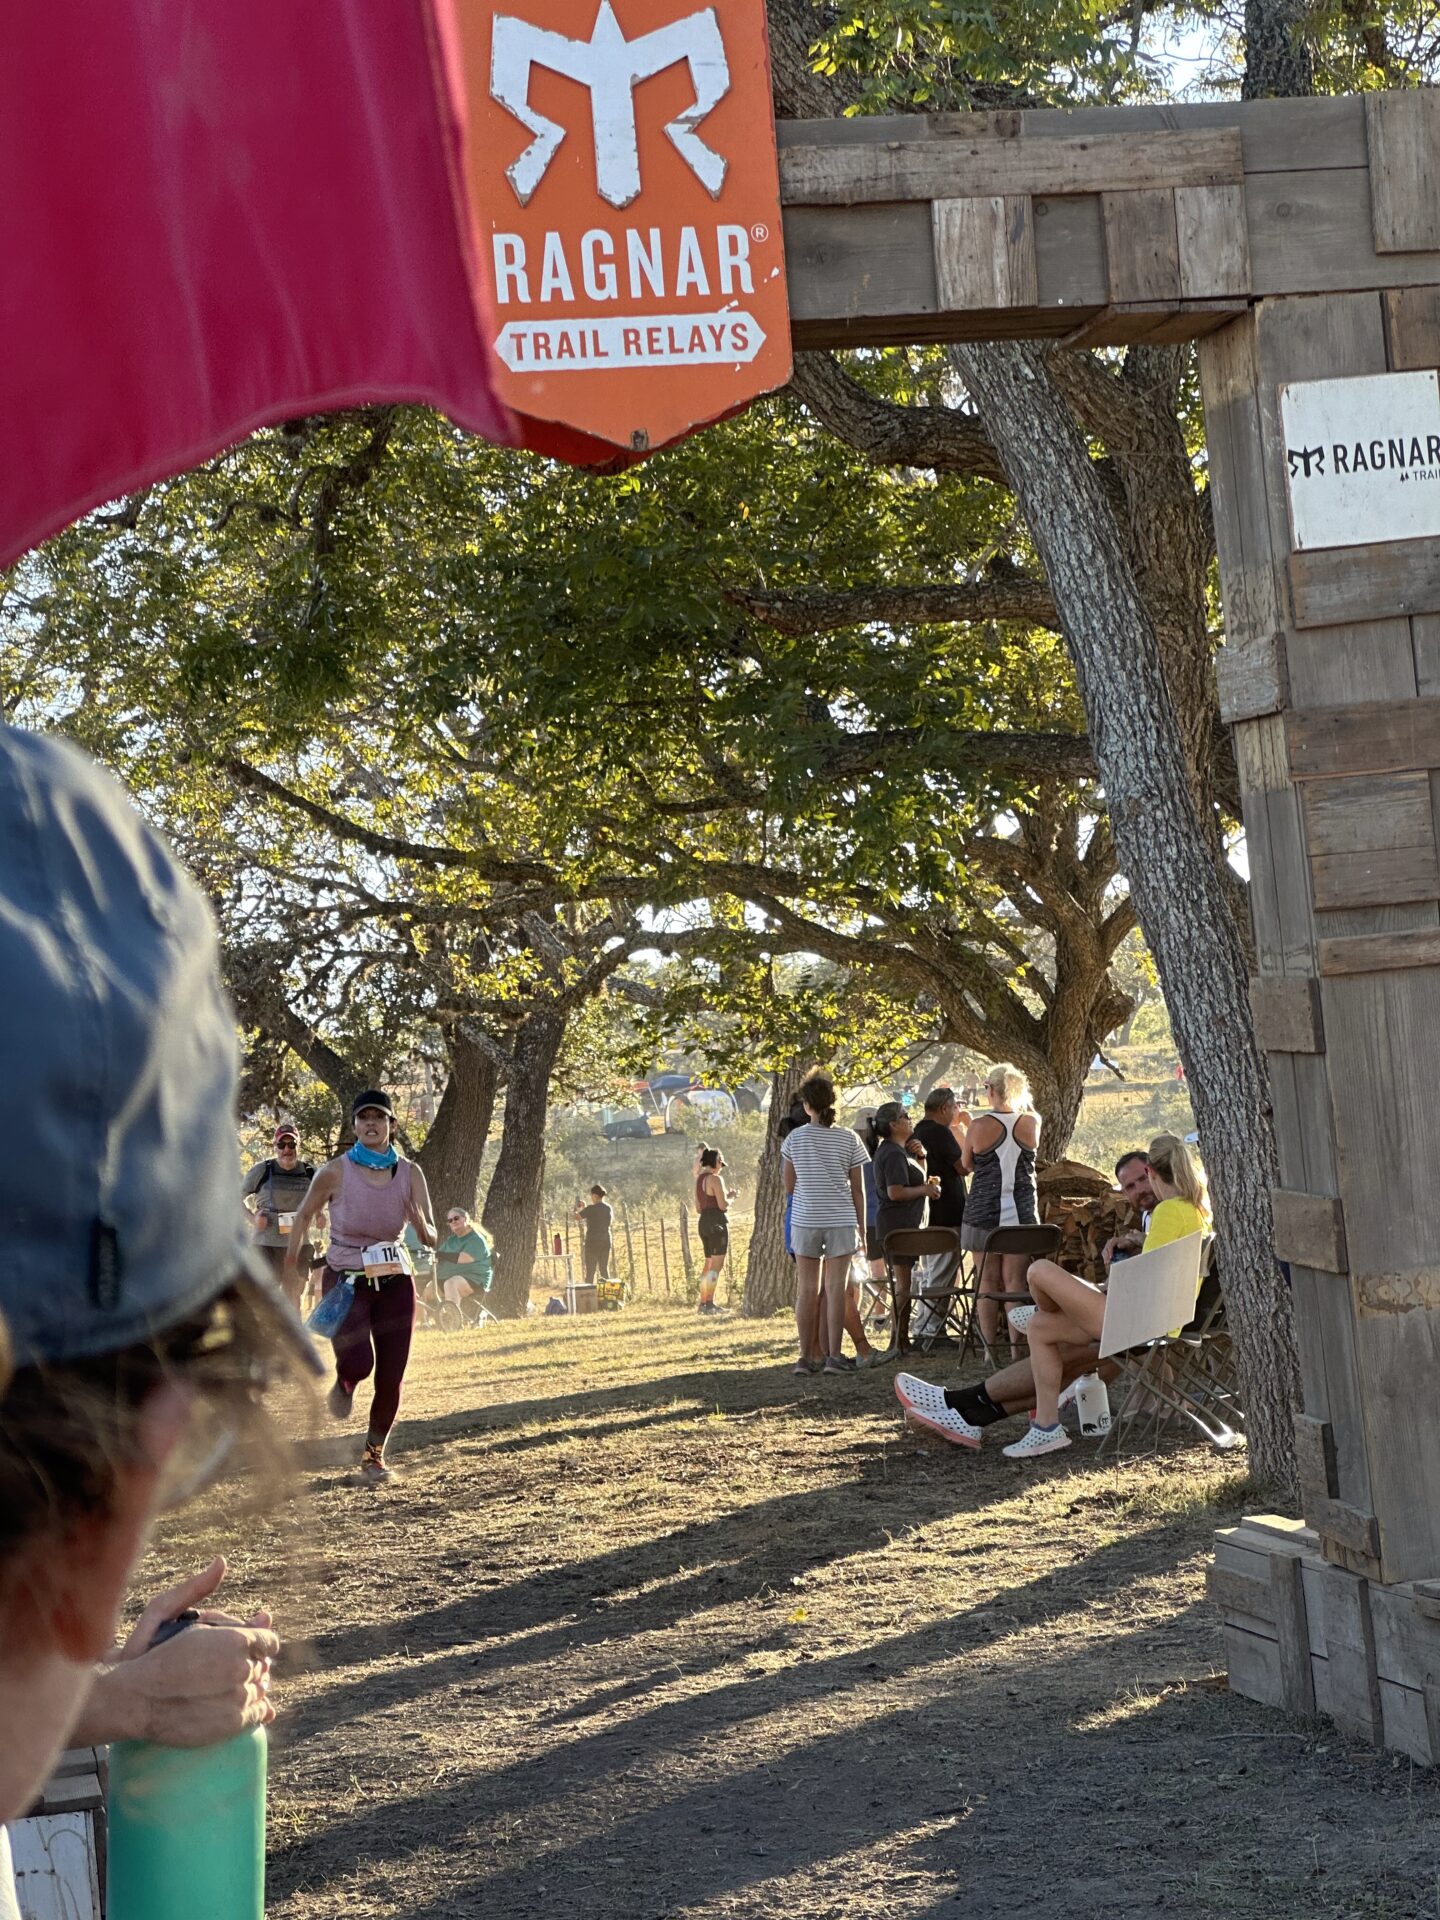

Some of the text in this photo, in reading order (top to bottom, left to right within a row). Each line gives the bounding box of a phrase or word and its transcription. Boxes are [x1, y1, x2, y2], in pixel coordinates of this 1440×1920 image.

[509, 322, 749, 361] TRAIL RELAYS
[1332, 435, 1440, 474] RAGNAR
[1412, 469, 1440, 481] TRAI
